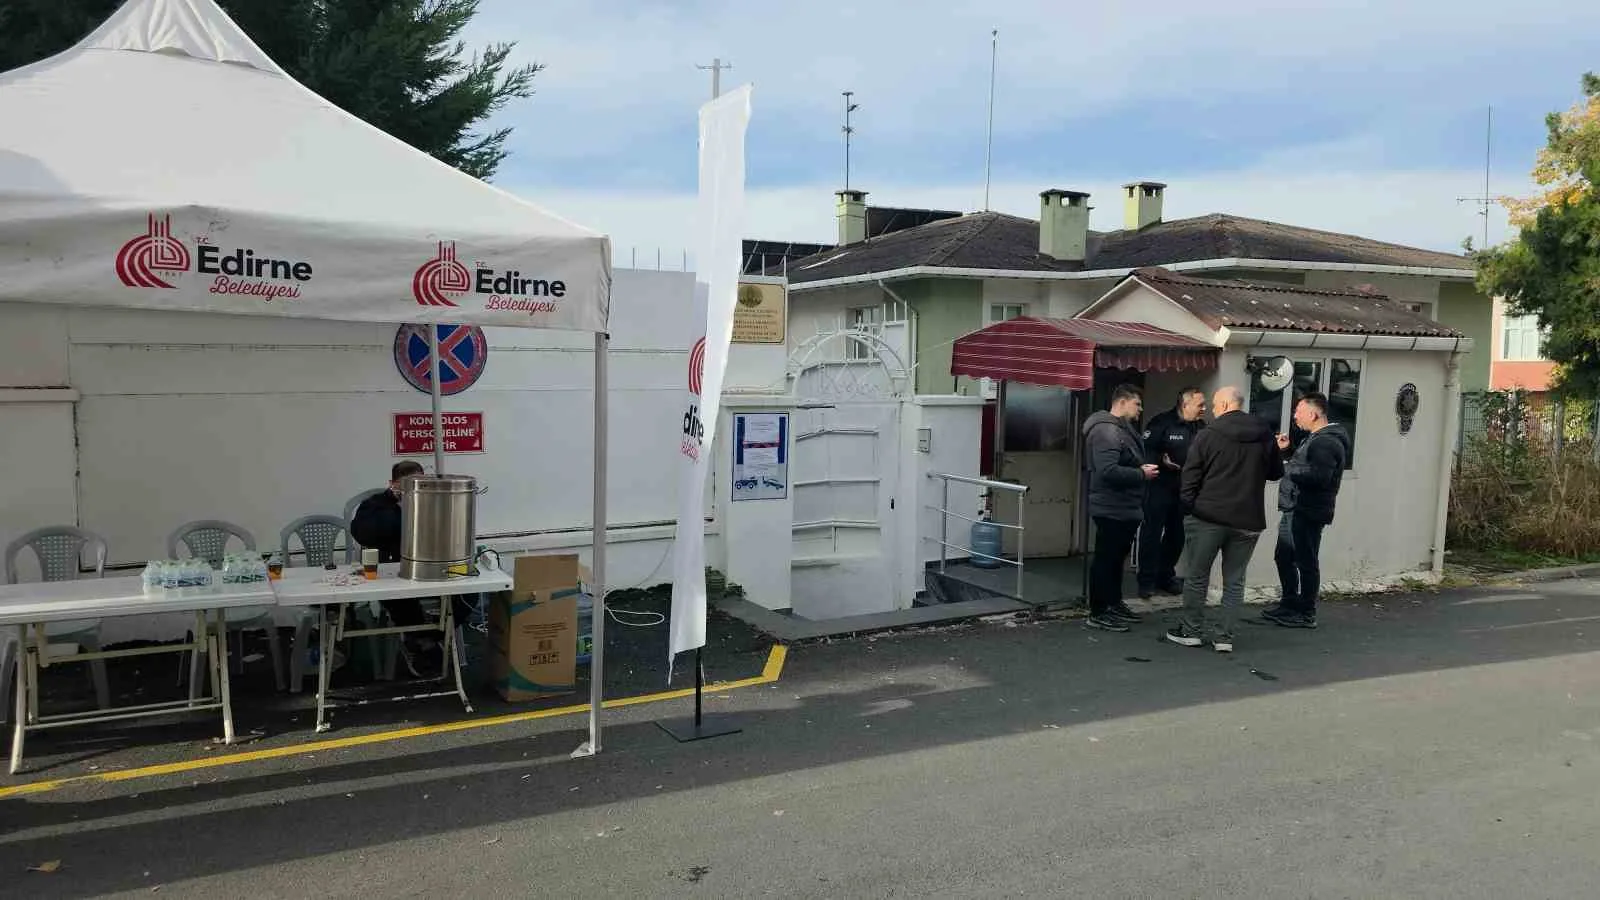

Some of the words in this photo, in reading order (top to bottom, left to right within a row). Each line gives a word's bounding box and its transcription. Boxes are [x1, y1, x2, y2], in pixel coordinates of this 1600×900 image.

[197, 245, 313, 281] Edirne
[209, 275, 301, 301] Belediyesi
[475, 268, 566, 298] Edirne
[485, 295, 557, 316] Belediyesi
[409, 416, 468, 425] KONOLOS
[422, 440, 457, 450] AİİR
